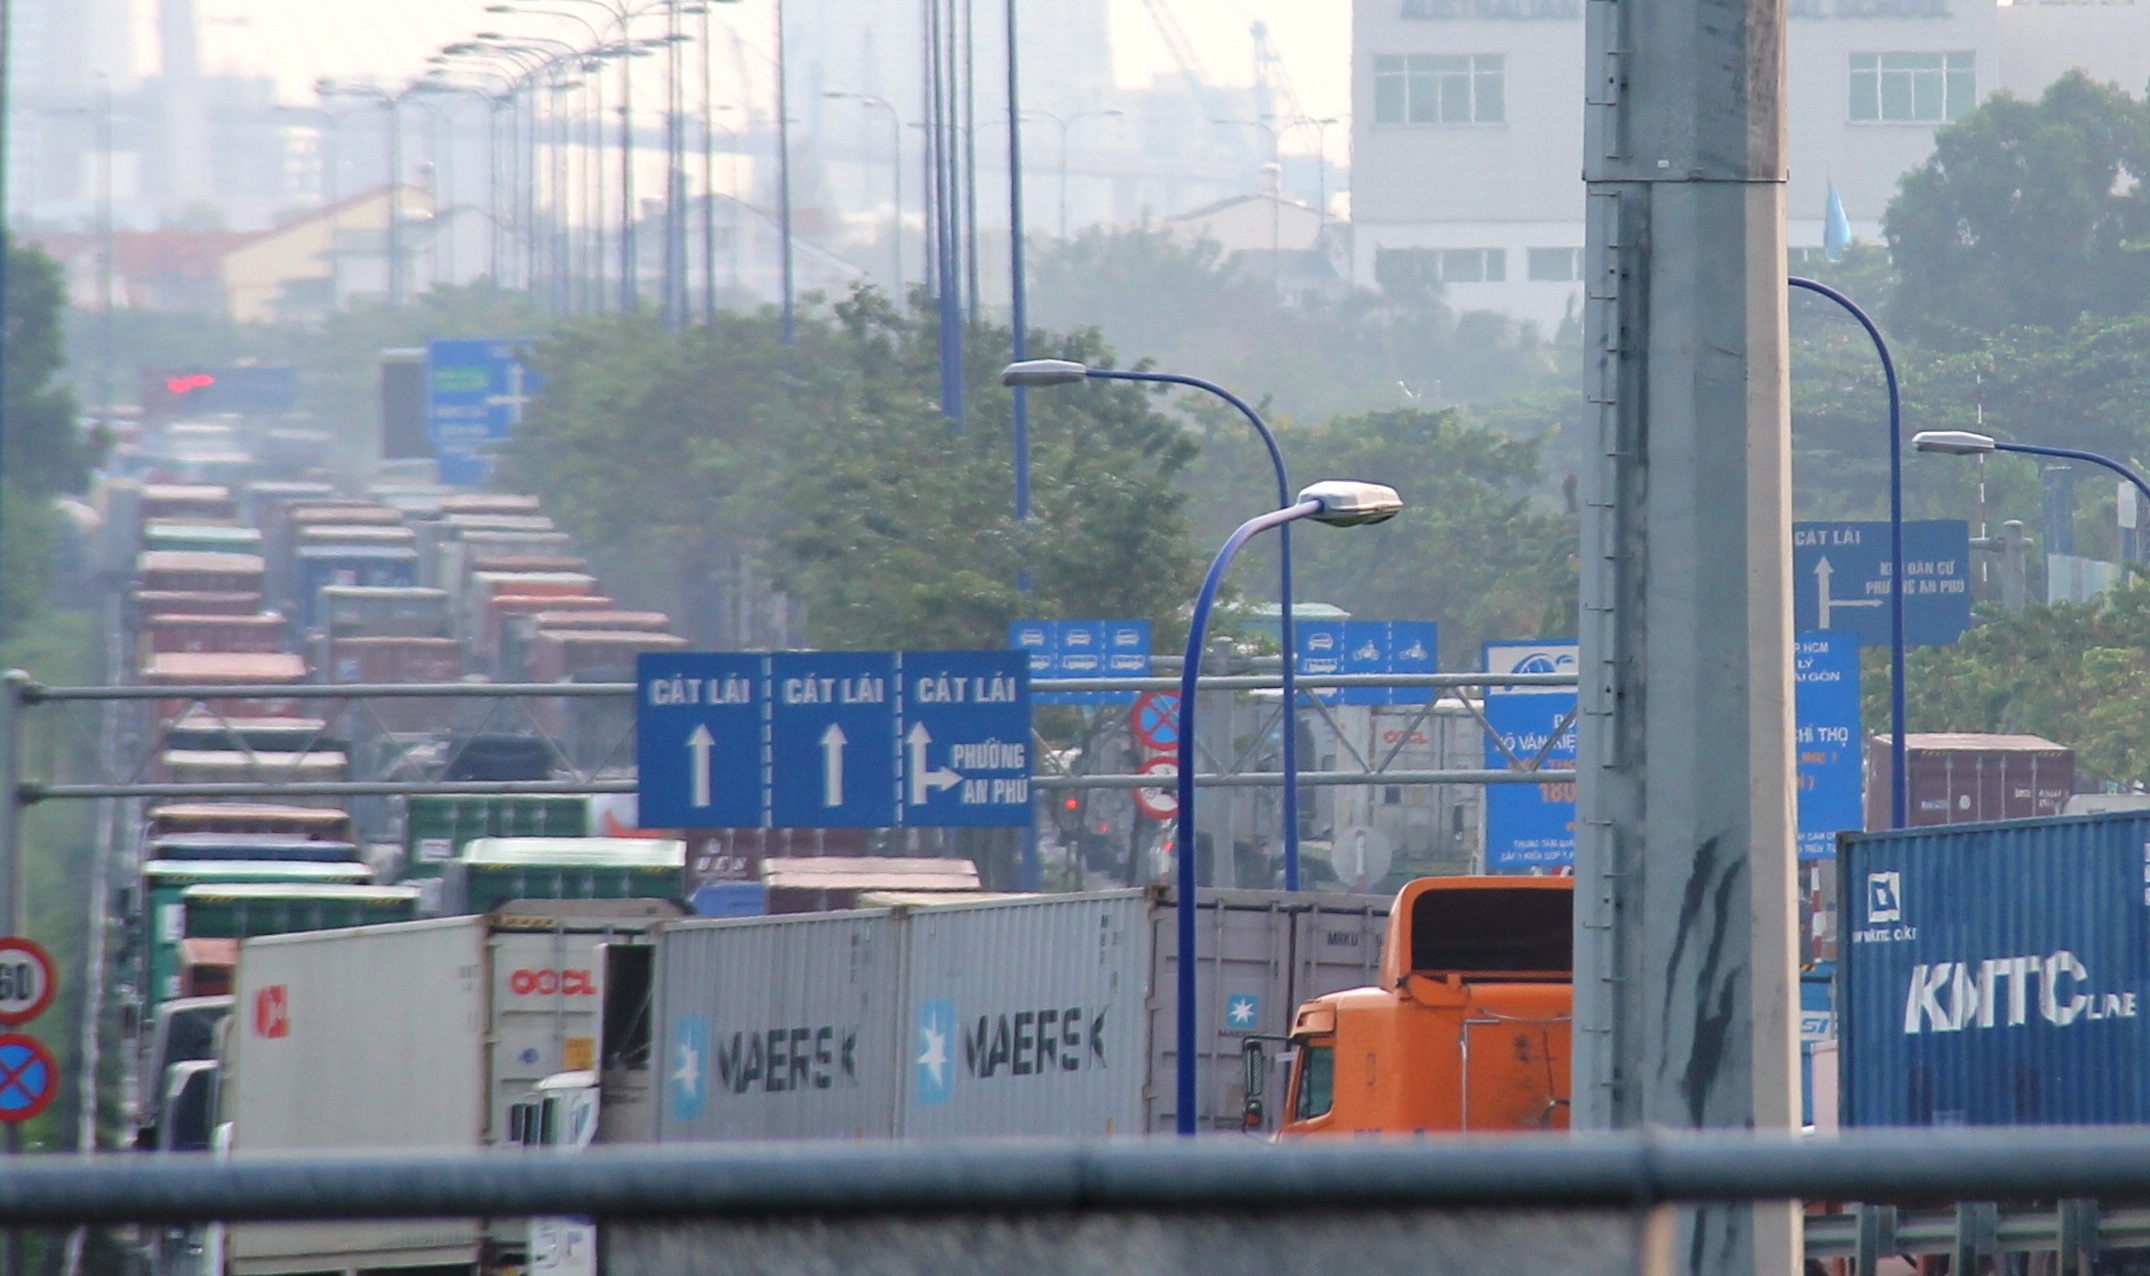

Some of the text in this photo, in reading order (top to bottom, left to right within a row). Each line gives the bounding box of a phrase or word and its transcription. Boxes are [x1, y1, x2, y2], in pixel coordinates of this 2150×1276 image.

[649, 672, 751, 704] CÁT LÁI
[784, 672, 884, 703] CÁT LÁI
[917, 671, 1016, 702] CÁT LÁI
[963, 773, 1028, 803] AN PHÚ
[510, 968, 598, 996] OOCL
[965, 1003, 1110, 1079] MAERSK
